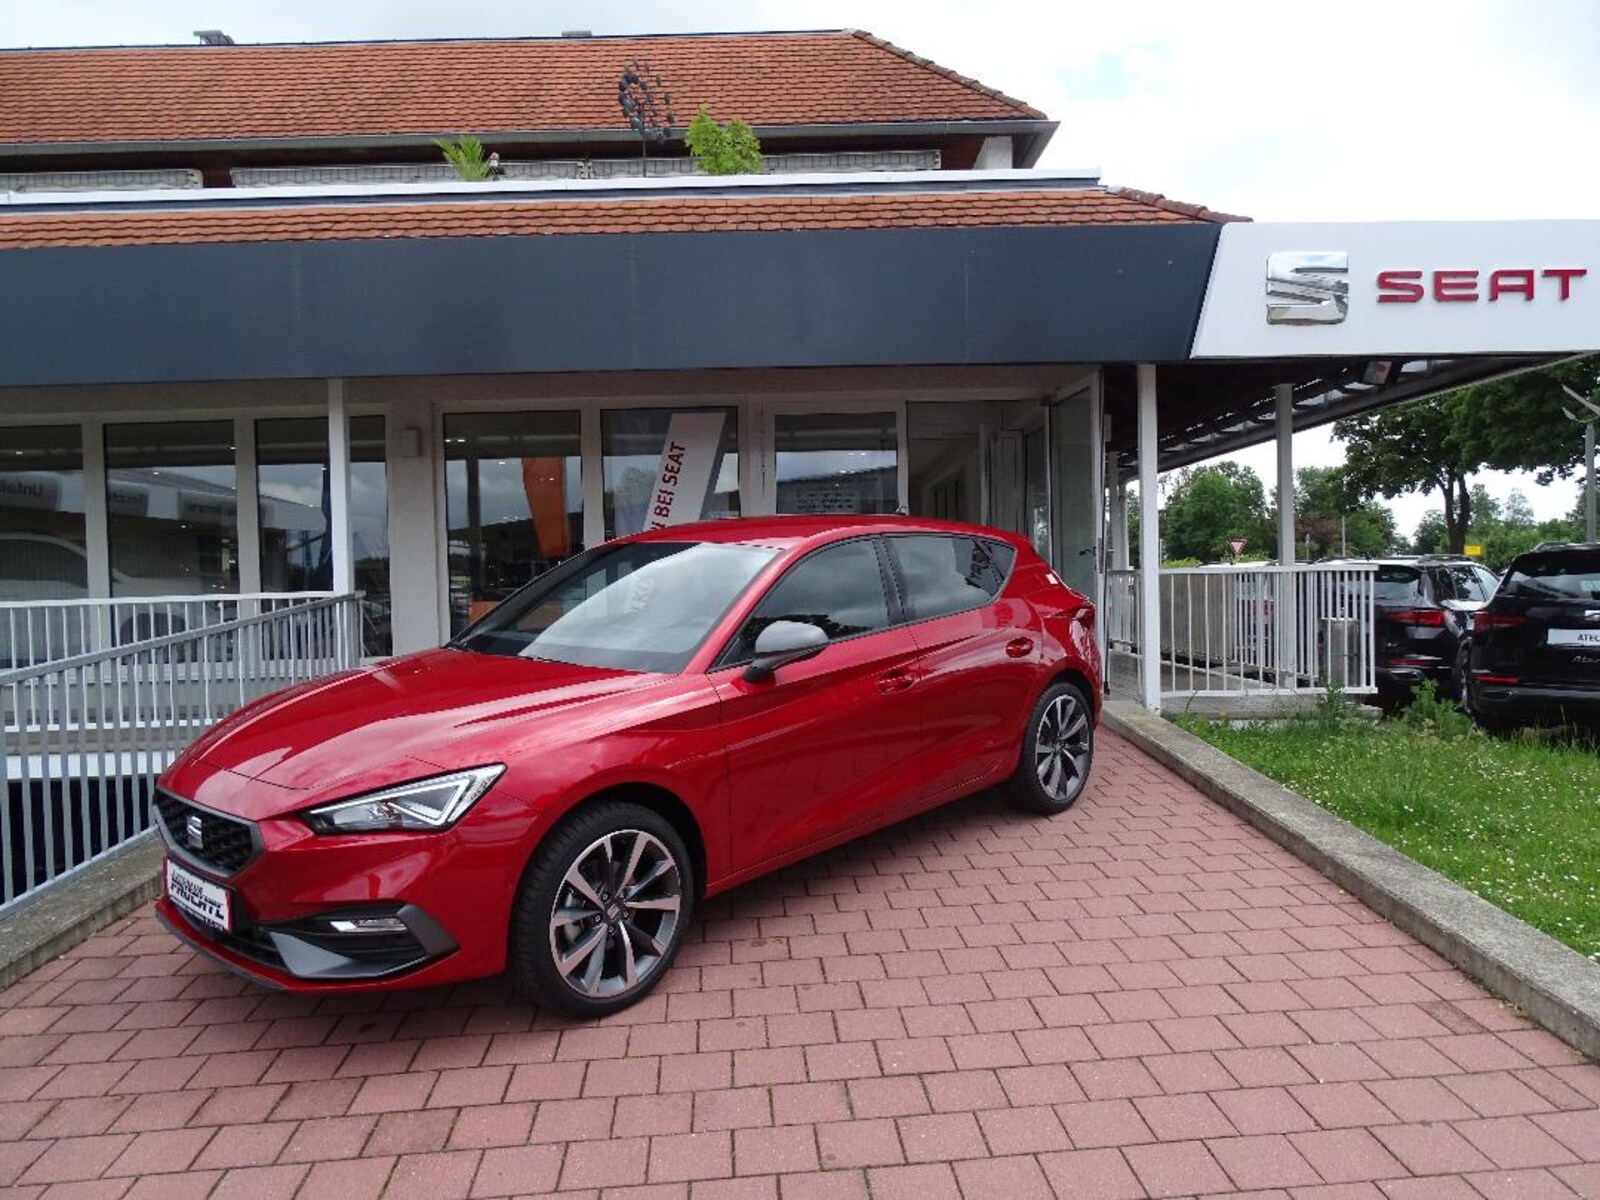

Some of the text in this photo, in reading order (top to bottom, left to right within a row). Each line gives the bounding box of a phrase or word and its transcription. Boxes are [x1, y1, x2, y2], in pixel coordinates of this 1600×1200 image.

[1376, 269, 1587, 303] SEAT
[662, 441, 685, 486] SEAT
[654, 488, 675, 518] BEI
